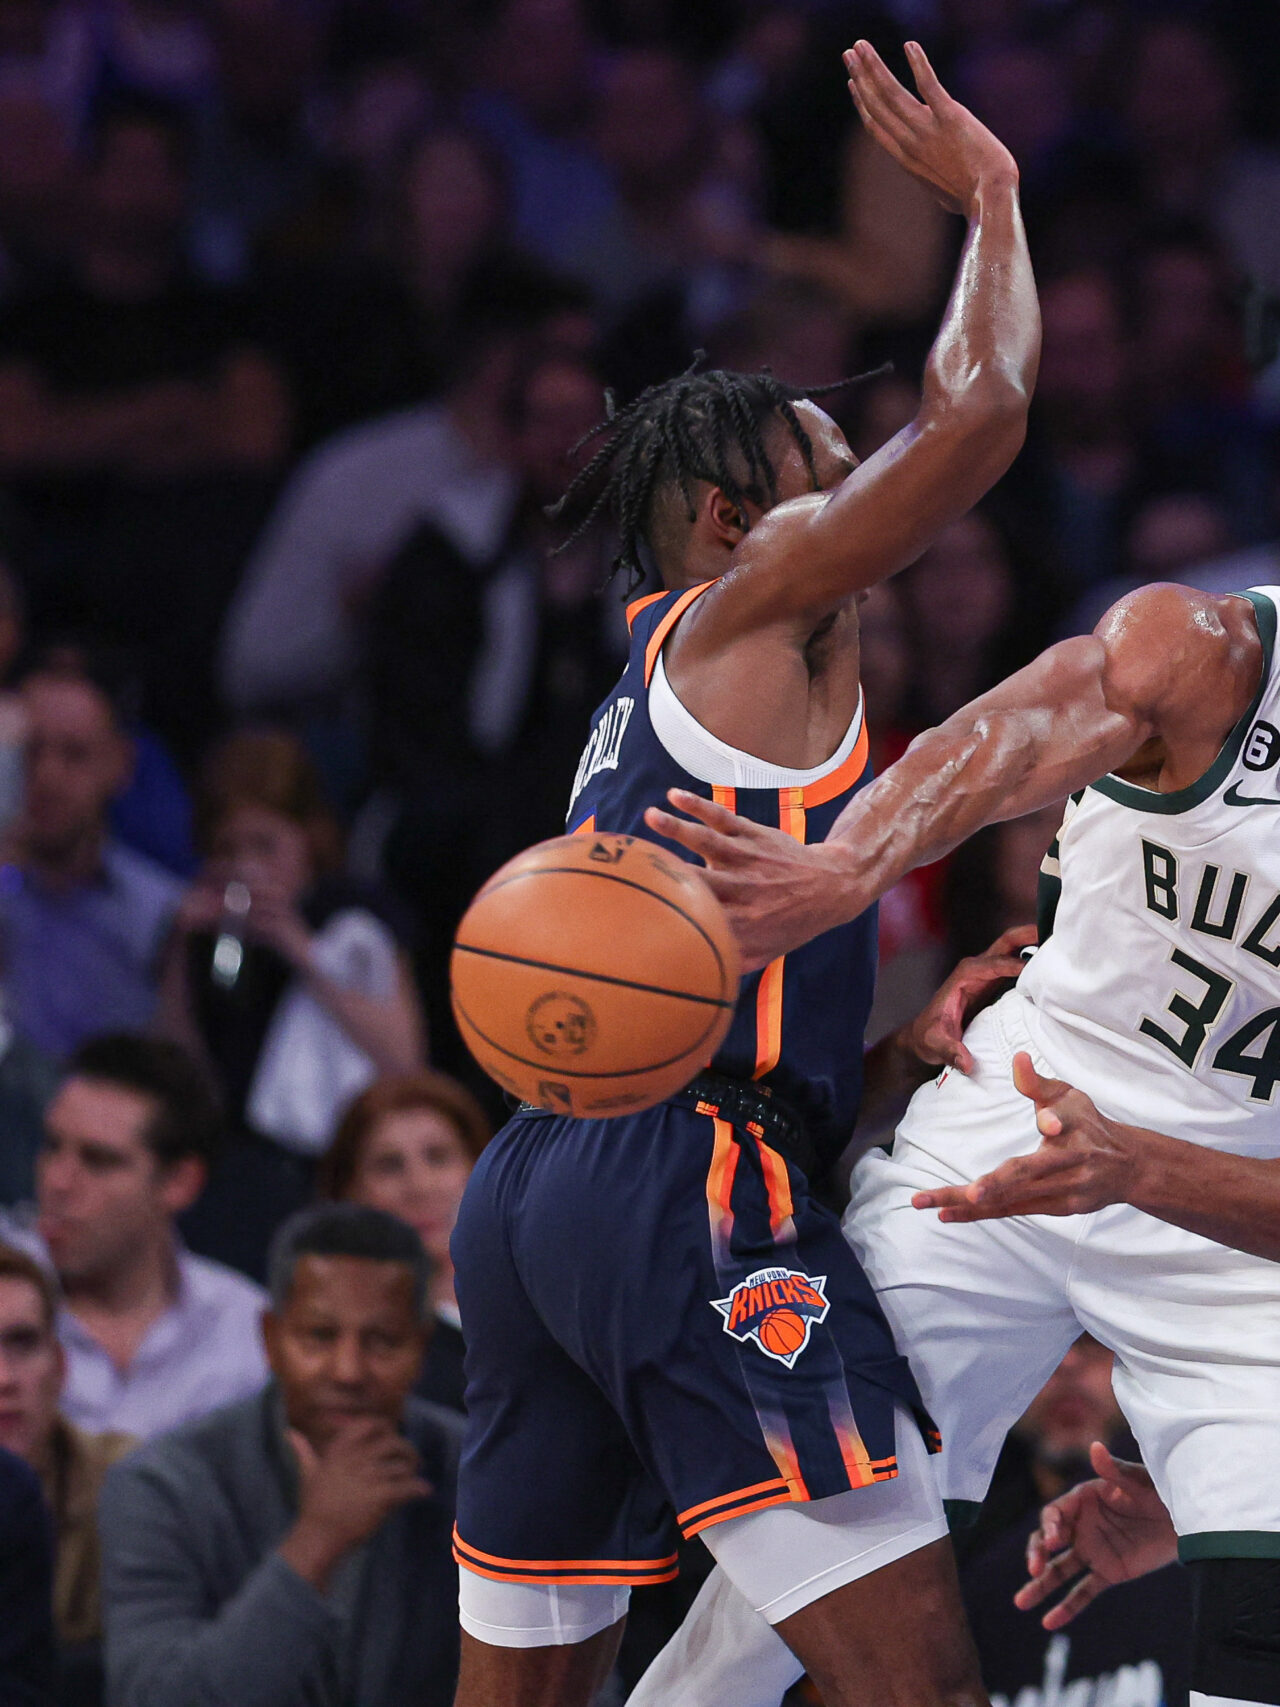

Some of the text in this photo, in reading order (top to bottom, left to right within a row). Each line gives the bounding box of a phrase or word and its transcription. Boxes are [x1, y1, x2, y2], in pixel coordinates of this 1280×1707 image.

[1244, 729, 1274, 767] 6
[749, 1269, 789, 1288] NEW YORK
[728, 1274, 827, 1331] KNICKS
